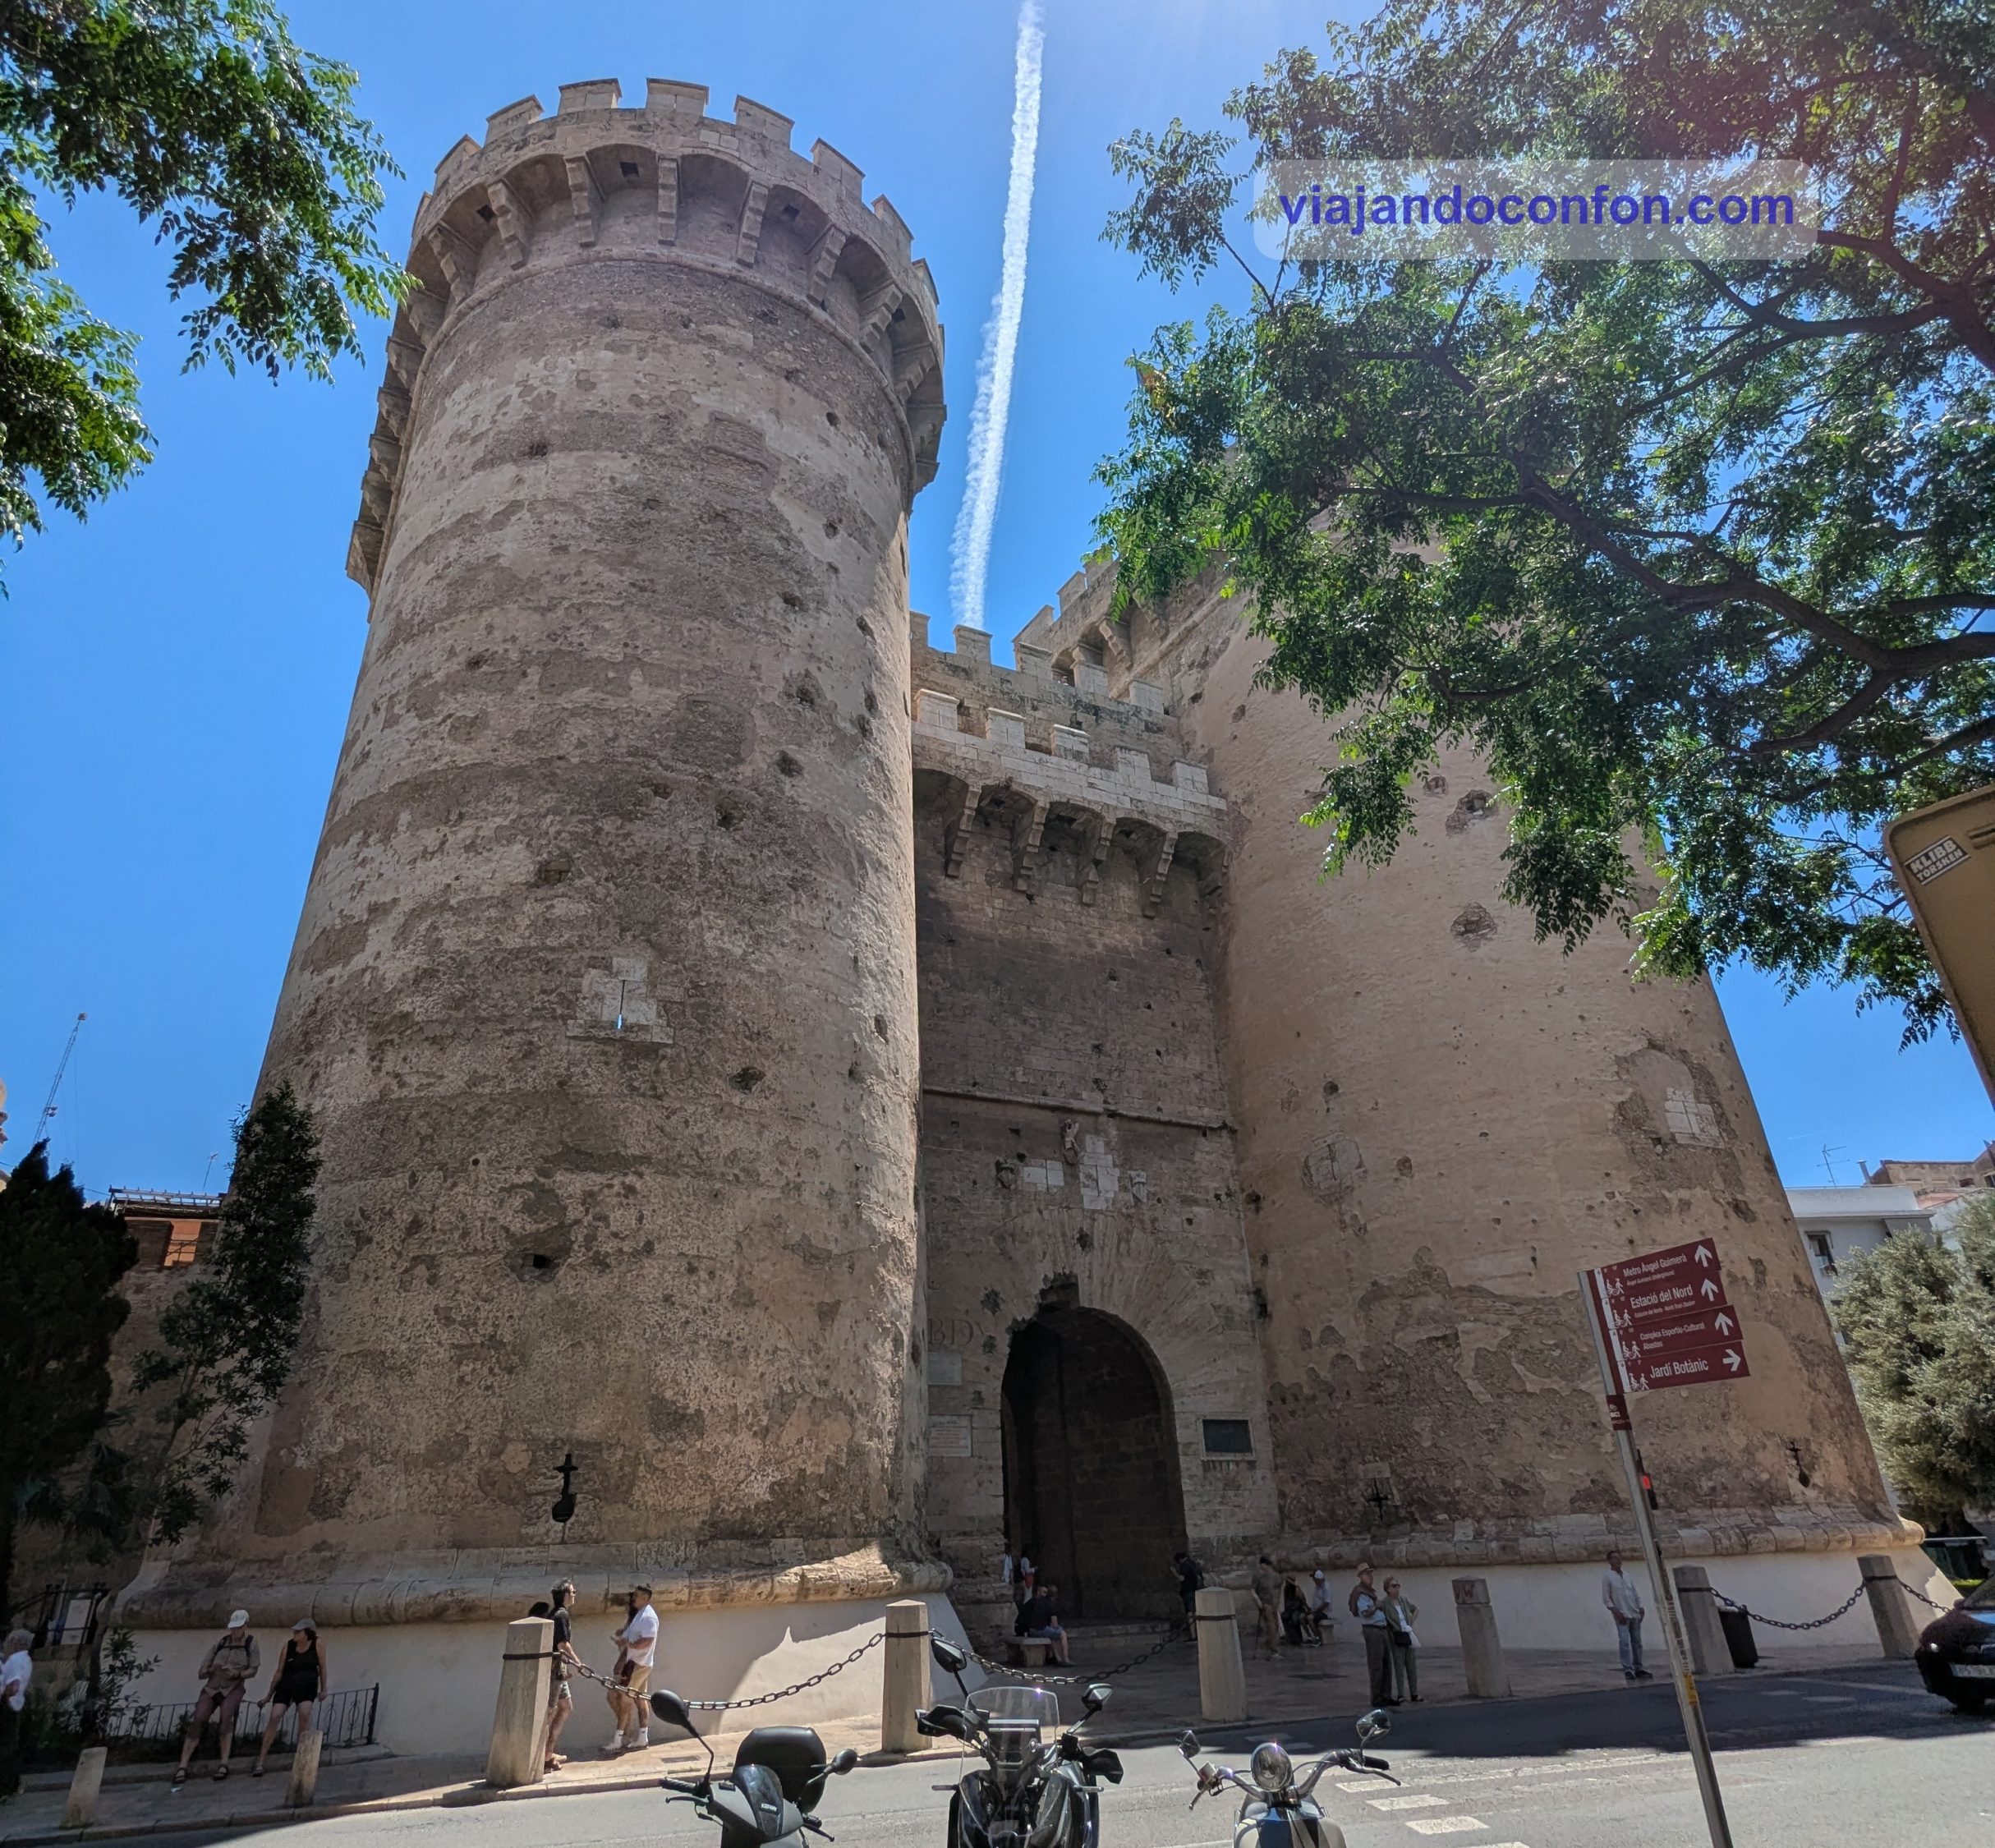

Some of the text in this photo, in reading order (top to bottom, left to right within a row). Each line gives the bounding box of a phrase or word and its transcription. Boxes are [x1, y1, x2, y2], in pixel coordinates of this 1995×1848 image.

[1910, 839, 1956, 873] KLIBB
[1916, 848, 1963, 880] TORSKEN
[1623, 1266, 1641, 1277] Metro
[1660, 1253, 1687, 1267] Guimerà
[1630, 1292, 1658, 1308] Estació
[1659, 1289, 1672, 1302] del
[1672, 1284, 1694, 1299] Nord
[1650, 1358, 1708, 1378] Jardí Botànic
